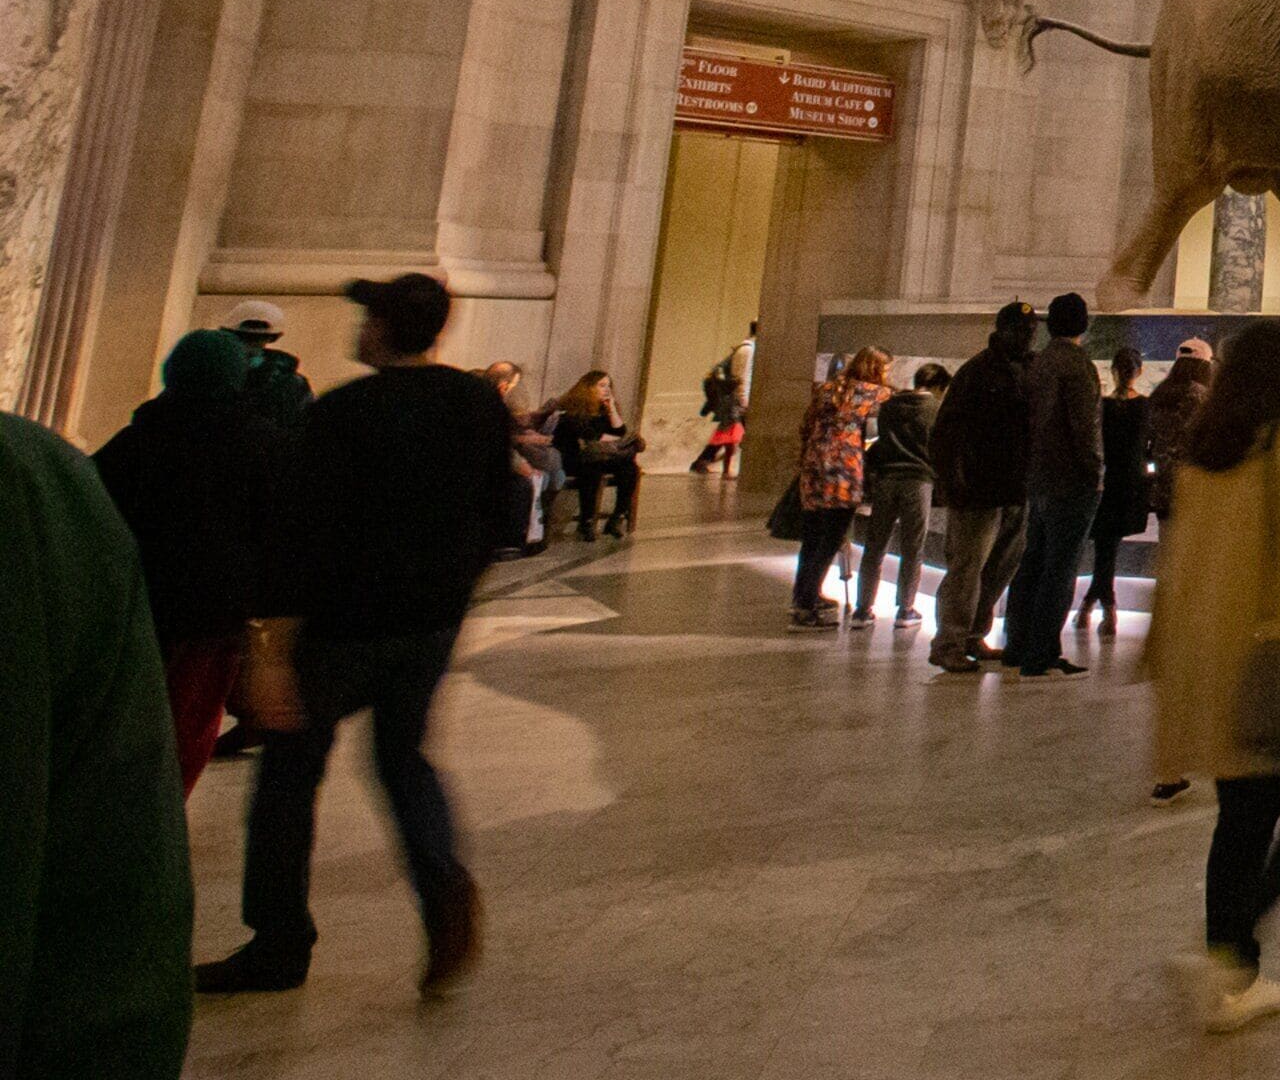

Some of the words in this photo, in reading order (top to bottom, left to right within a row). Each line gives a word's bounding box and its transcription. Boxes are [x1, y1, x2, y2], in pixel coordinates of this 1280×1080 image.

[698, 60, 738, 76] FLOOR
[793, 73, 827, 89] BAIRD
[829, 80, 892, 98] AUDITORIUM
[792, 91, 833, 107] ATRIUM
[790, 107, 835, 124] MUSEUM
[837, 113, 866, 127] SHOP
